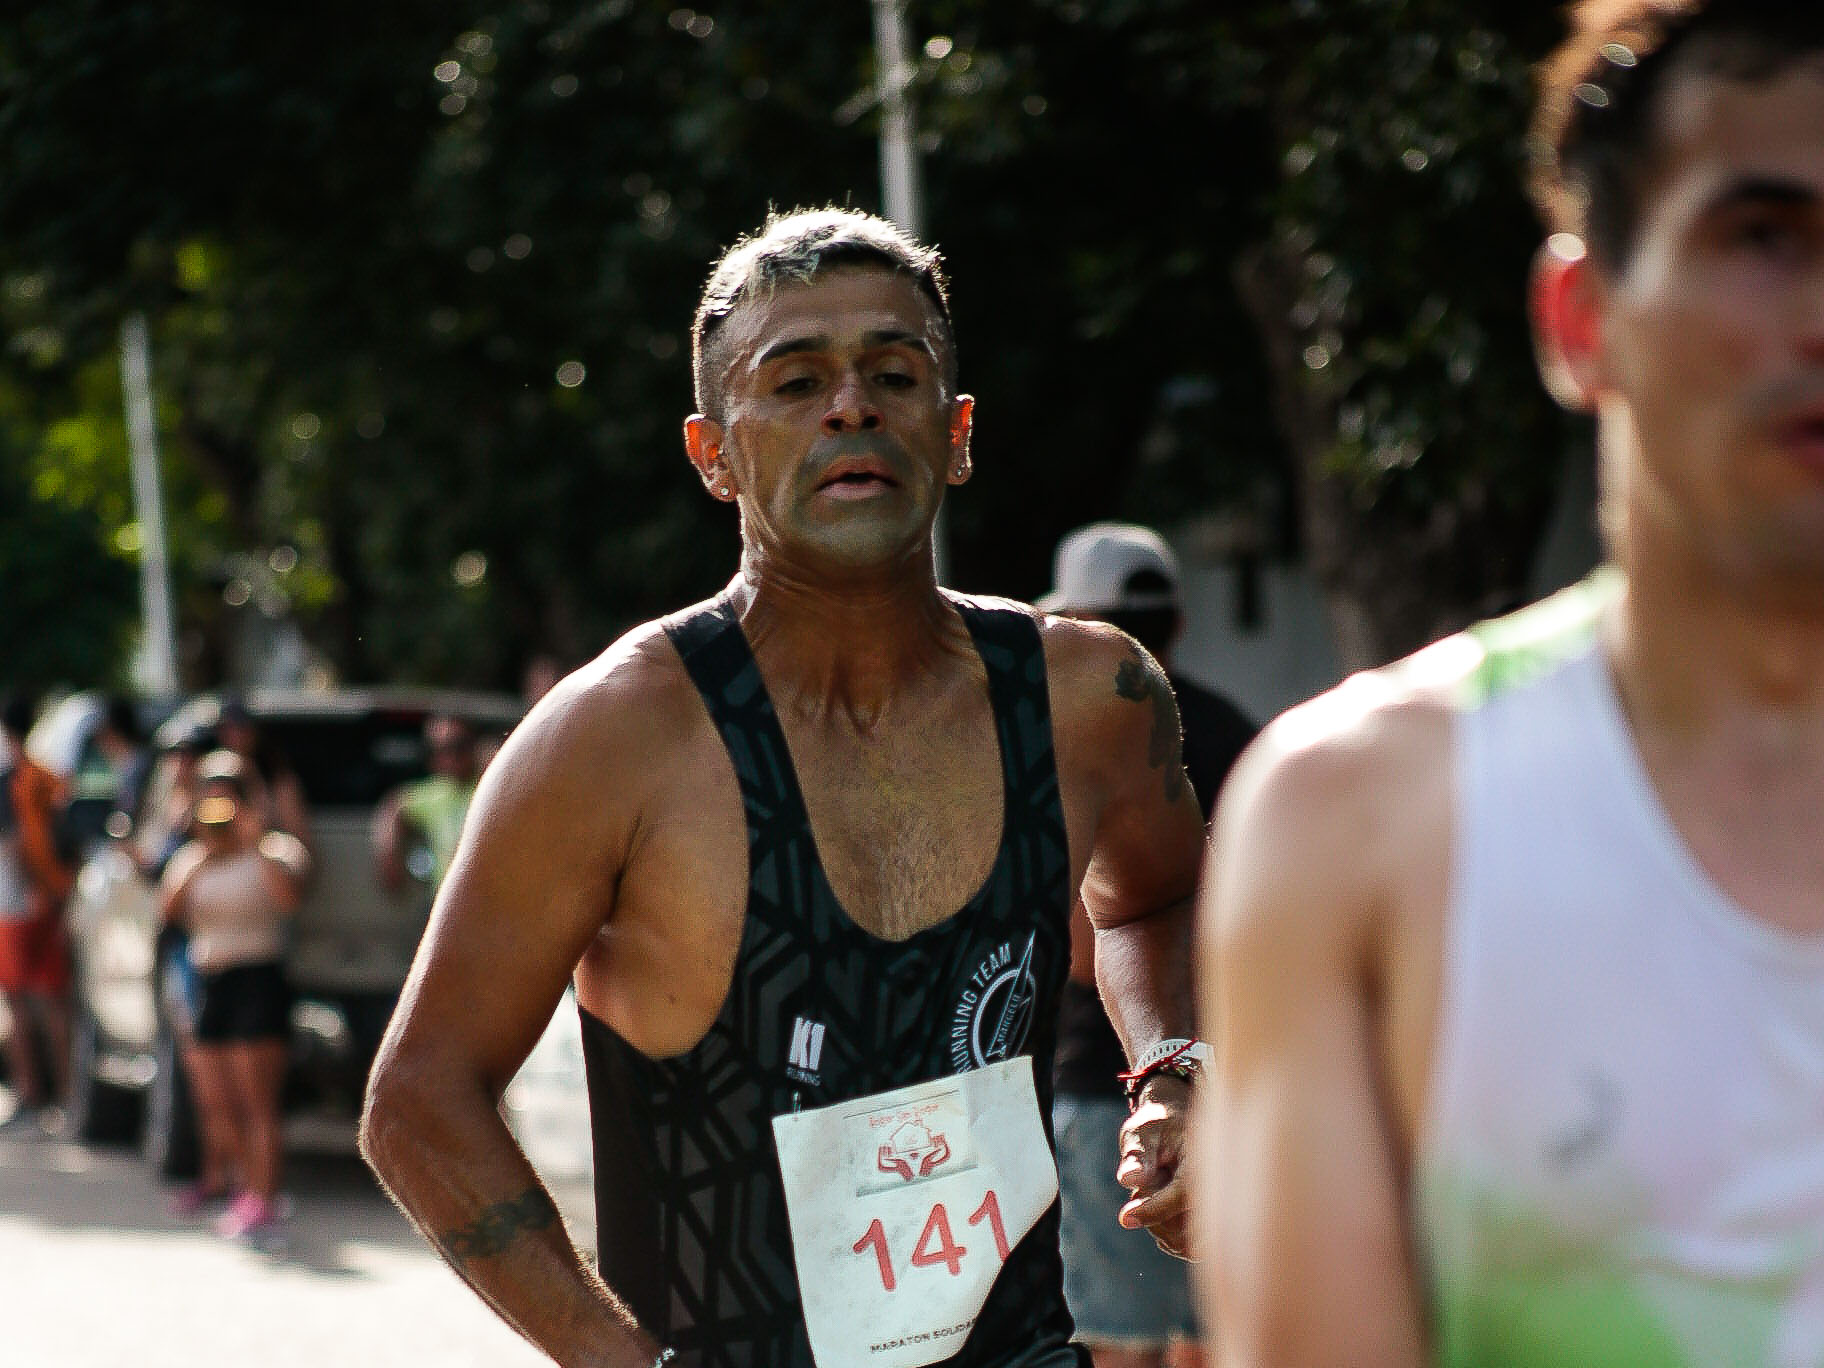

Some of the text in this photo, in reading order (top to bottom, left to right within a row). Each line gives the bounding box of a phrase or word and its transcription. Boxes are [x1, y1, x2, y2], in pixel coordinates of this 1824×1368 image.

[972, 942, 1011, 988] TEAM
[853, 1190, 1011, 1292] 141
[870, 1332, 931, 1353] MARATON
